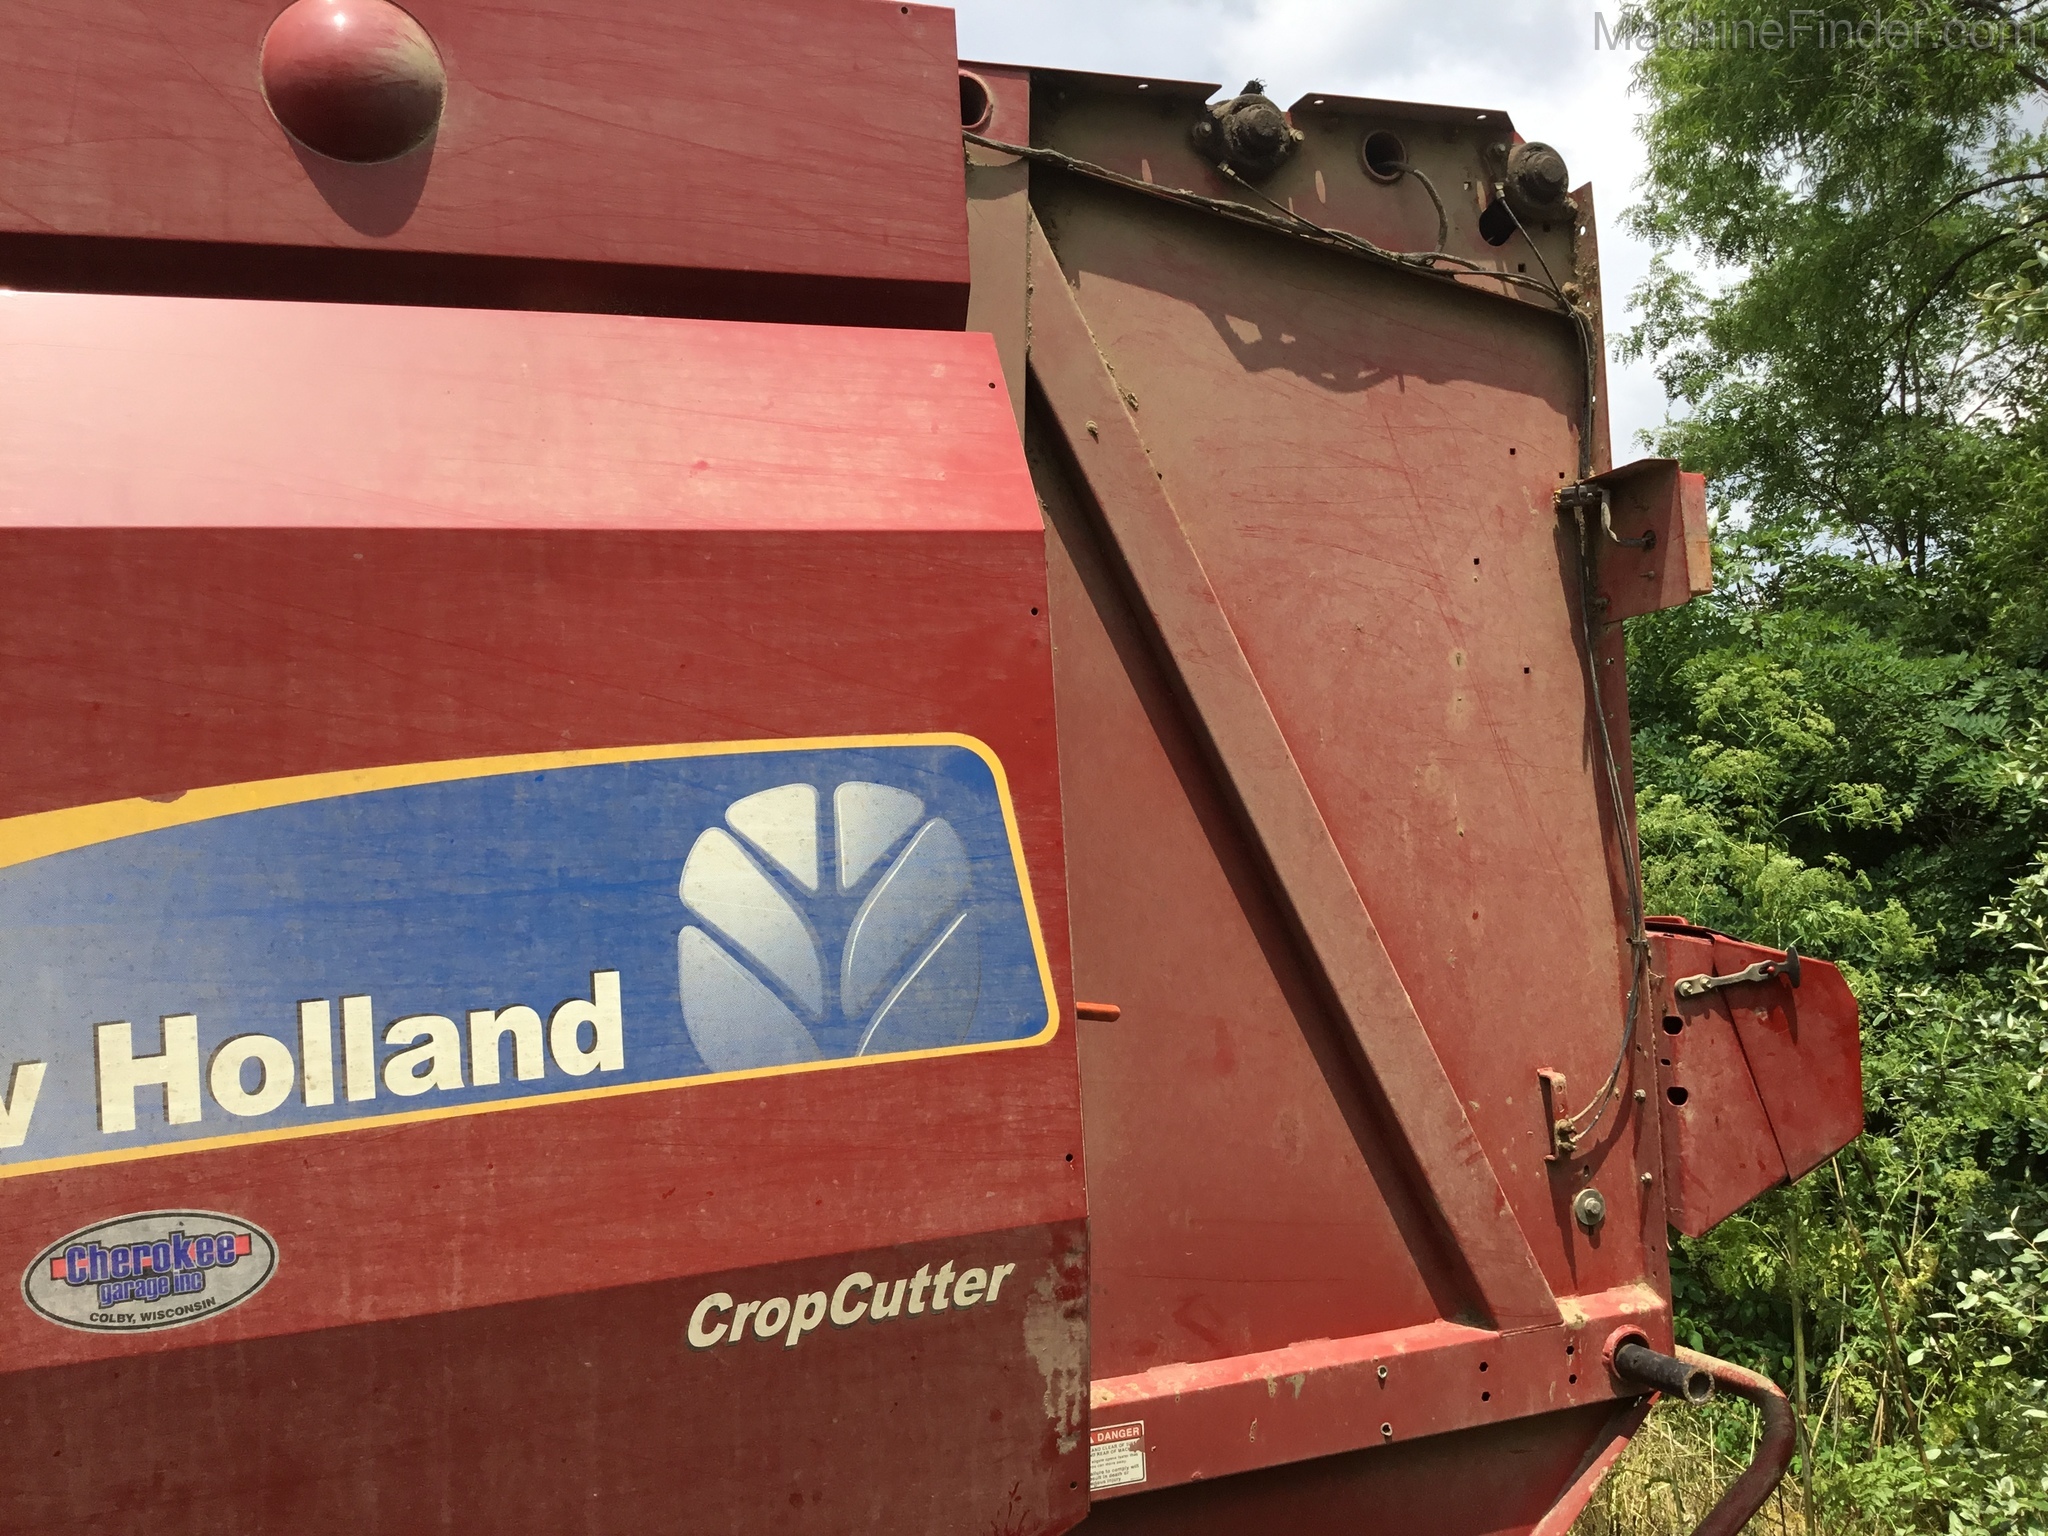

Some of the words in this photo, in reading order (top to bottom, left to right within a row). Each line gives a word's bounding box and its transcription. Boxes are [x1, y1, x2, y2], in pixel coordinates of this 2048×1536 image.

[95, 970, 625, 1134] Holland
[65, 1232, 237, 1284] Cherokee
[99, 1274, 170, 1306] garage
[173, 1270, 203, 1293] inc
[687, 1258, 1016, 1348] CropCutter
[89, 1311, 137, 1325] COLBY,
[139, 1296, 217, 1322] WISCONSIN
[1097, 1426, 1139, 1442] DANGER
